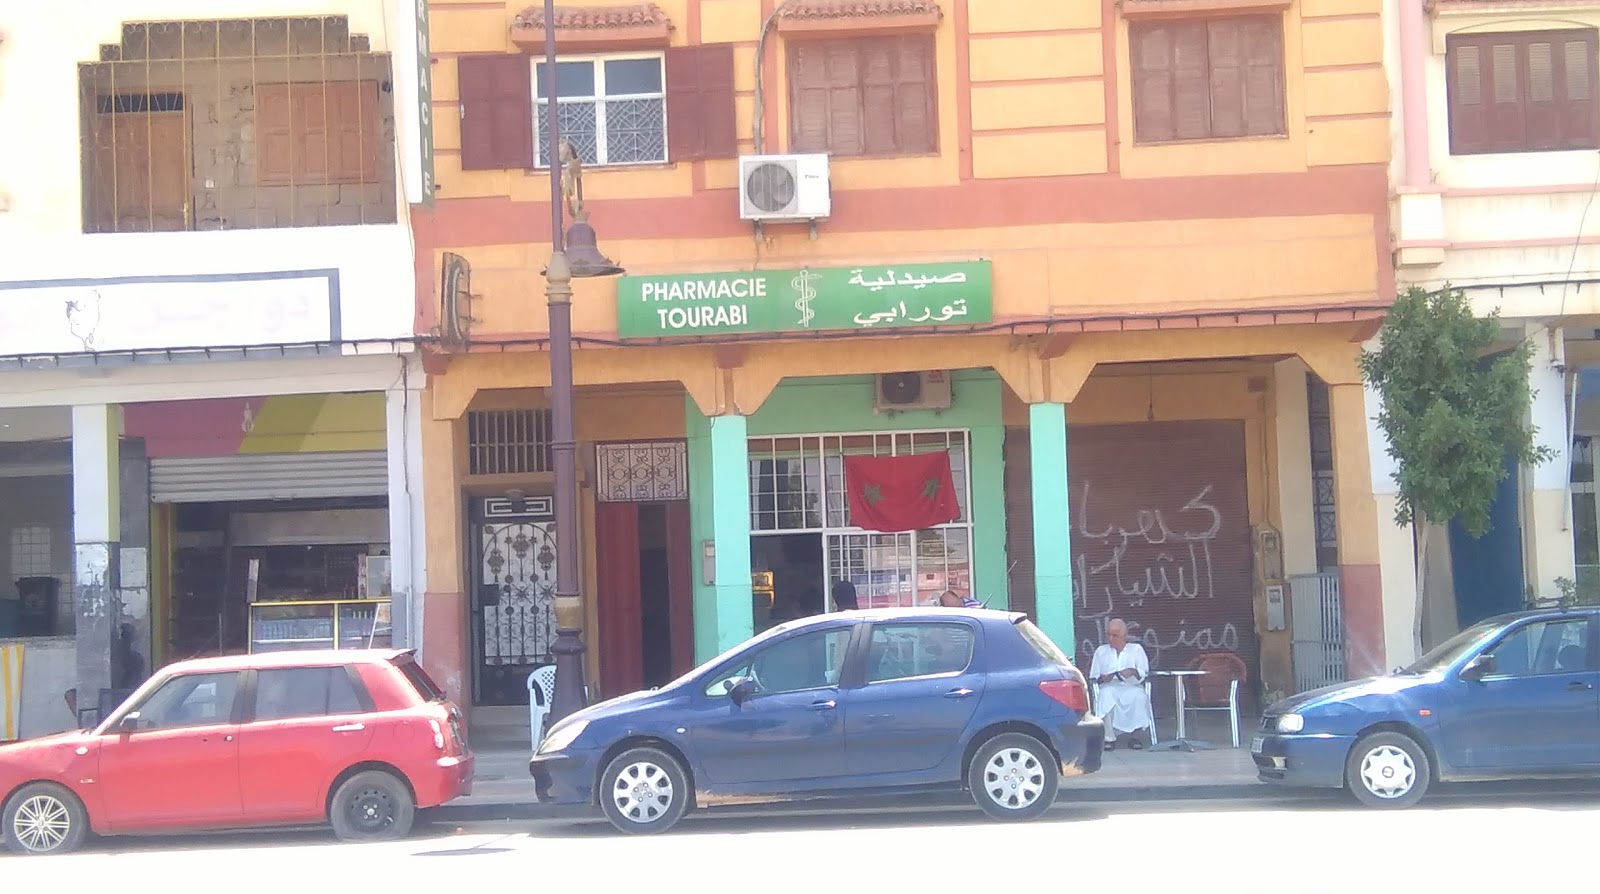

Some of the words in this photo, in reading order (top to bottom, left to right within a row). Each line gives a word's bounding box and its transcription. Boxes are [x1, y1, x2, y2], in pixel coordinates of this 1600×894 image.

[642, 278, 767, 302] PHARMACIE
[848, 269, 967, 291] صيدلية
[657, 305, 748, 330] TOURABI
[853, 299, 968, 327] تورابي
